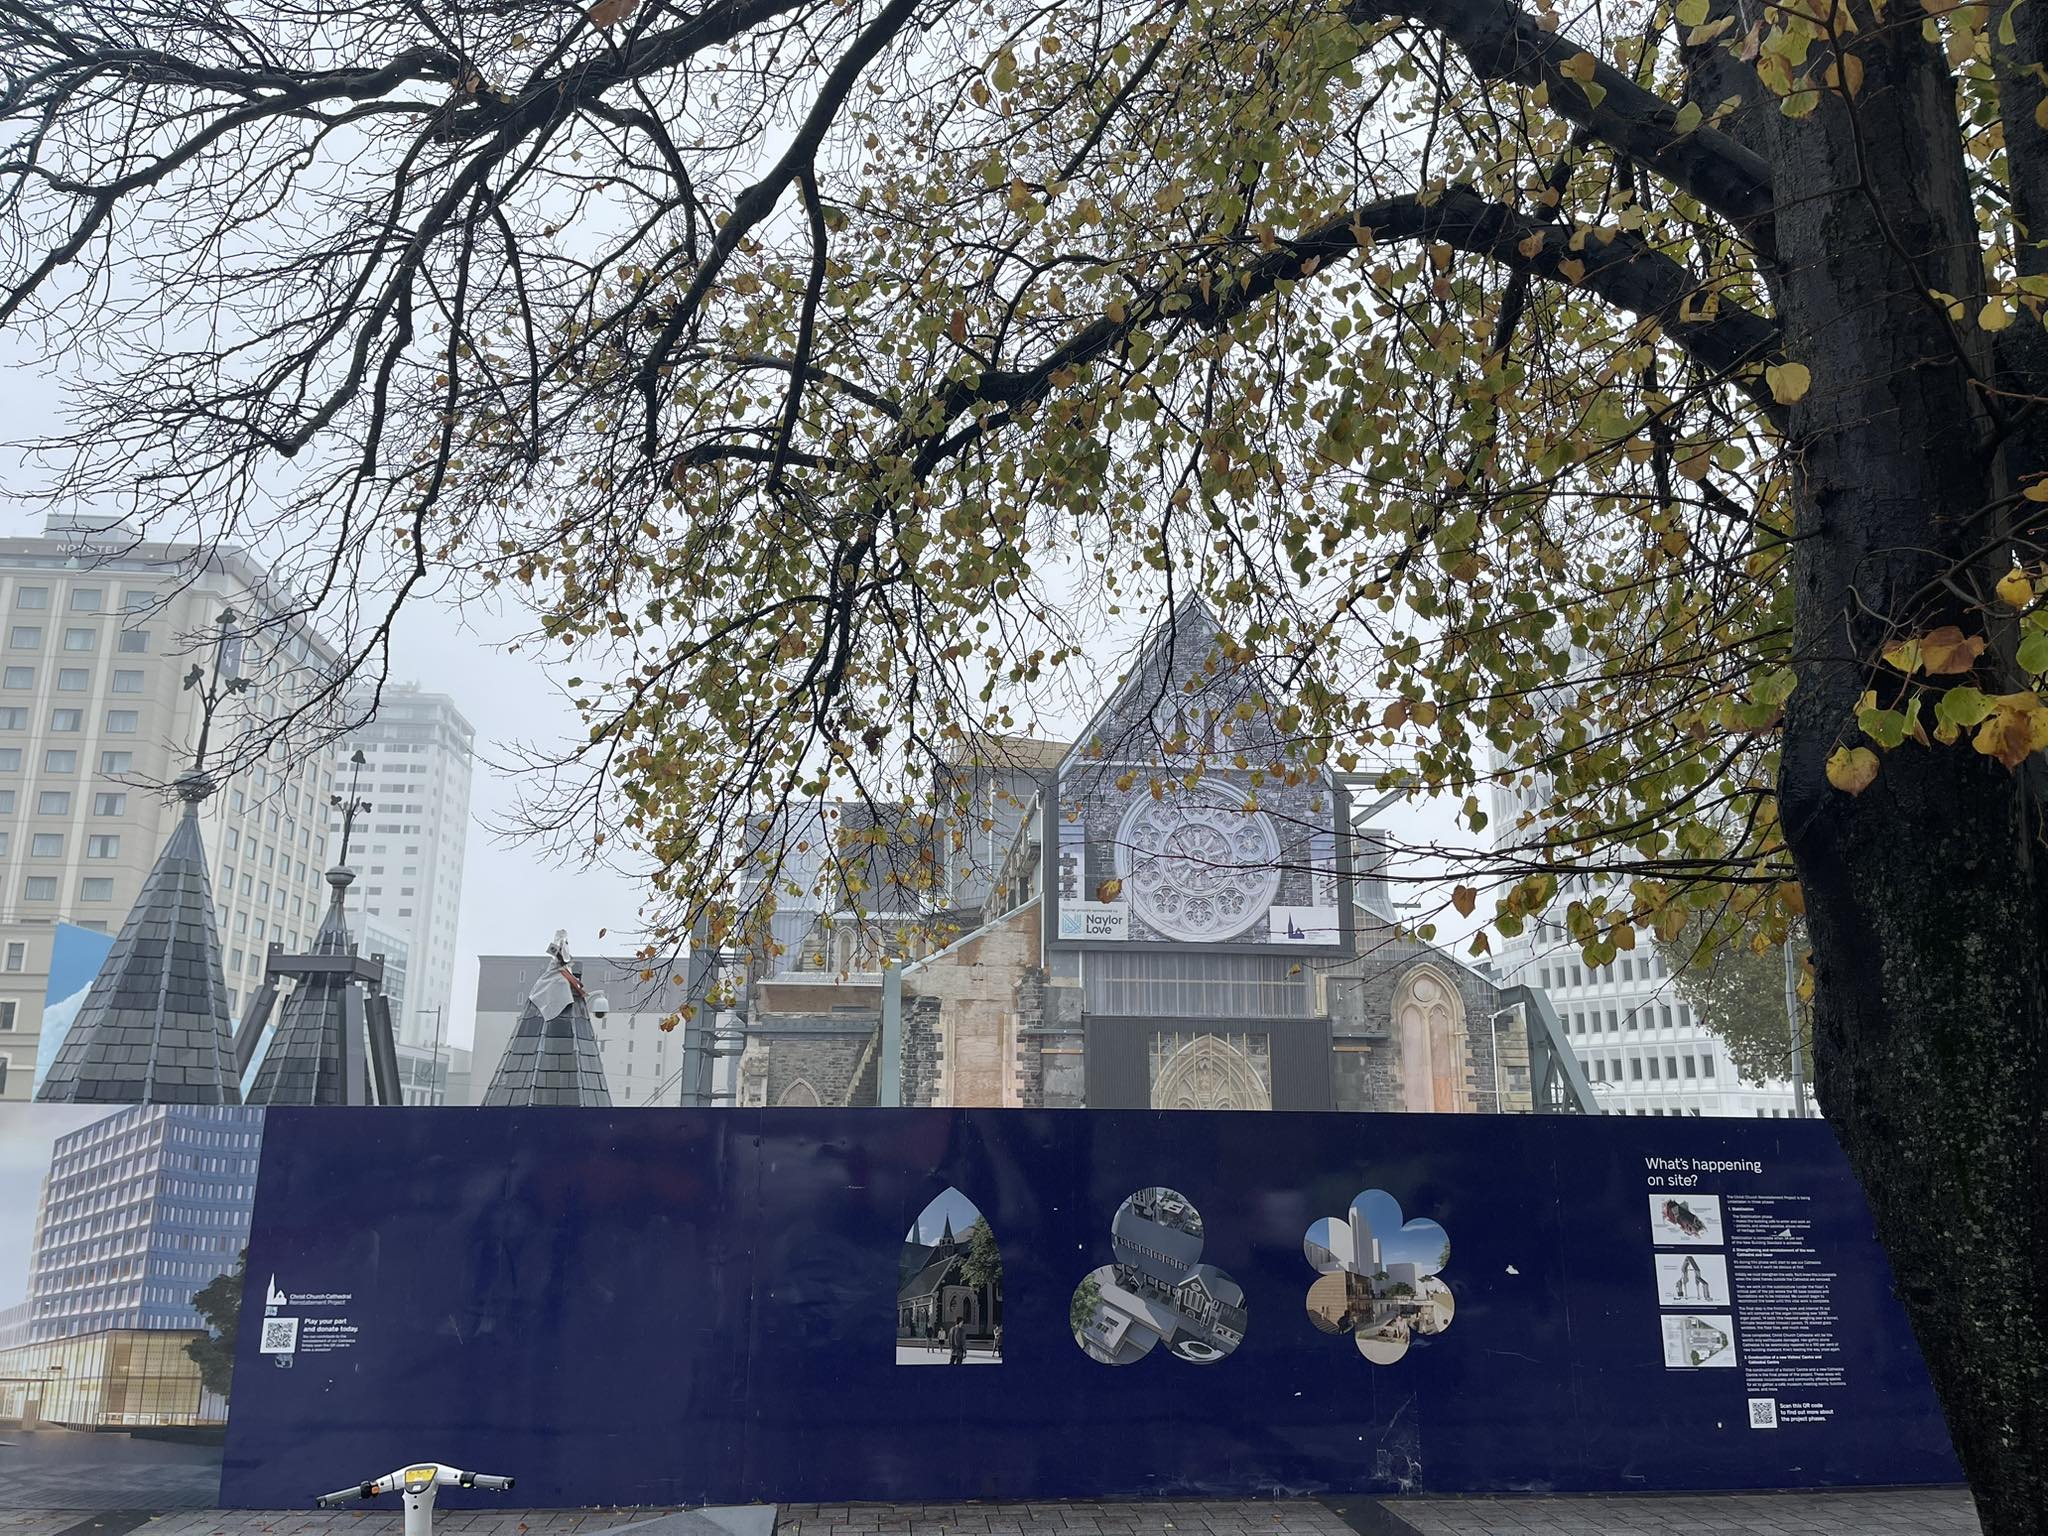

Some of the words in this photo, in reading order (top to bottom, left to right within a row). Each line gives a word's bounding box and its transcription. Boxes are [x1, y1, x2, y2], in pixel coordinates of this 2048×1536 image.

[1086, 914, 1123, 926] Naylor
[1086, 925, 1112, 934] Love
[1645, 1157, 1689, 1170] What's
[1692, 1158, 1762, 1174] happening
[1647, 1176, 1664, 1186] on
[1667, 1174, 1698, 1187] site?
[304, 1318, 318, 1326] Play
[334, 1318, 347, 1326] part
